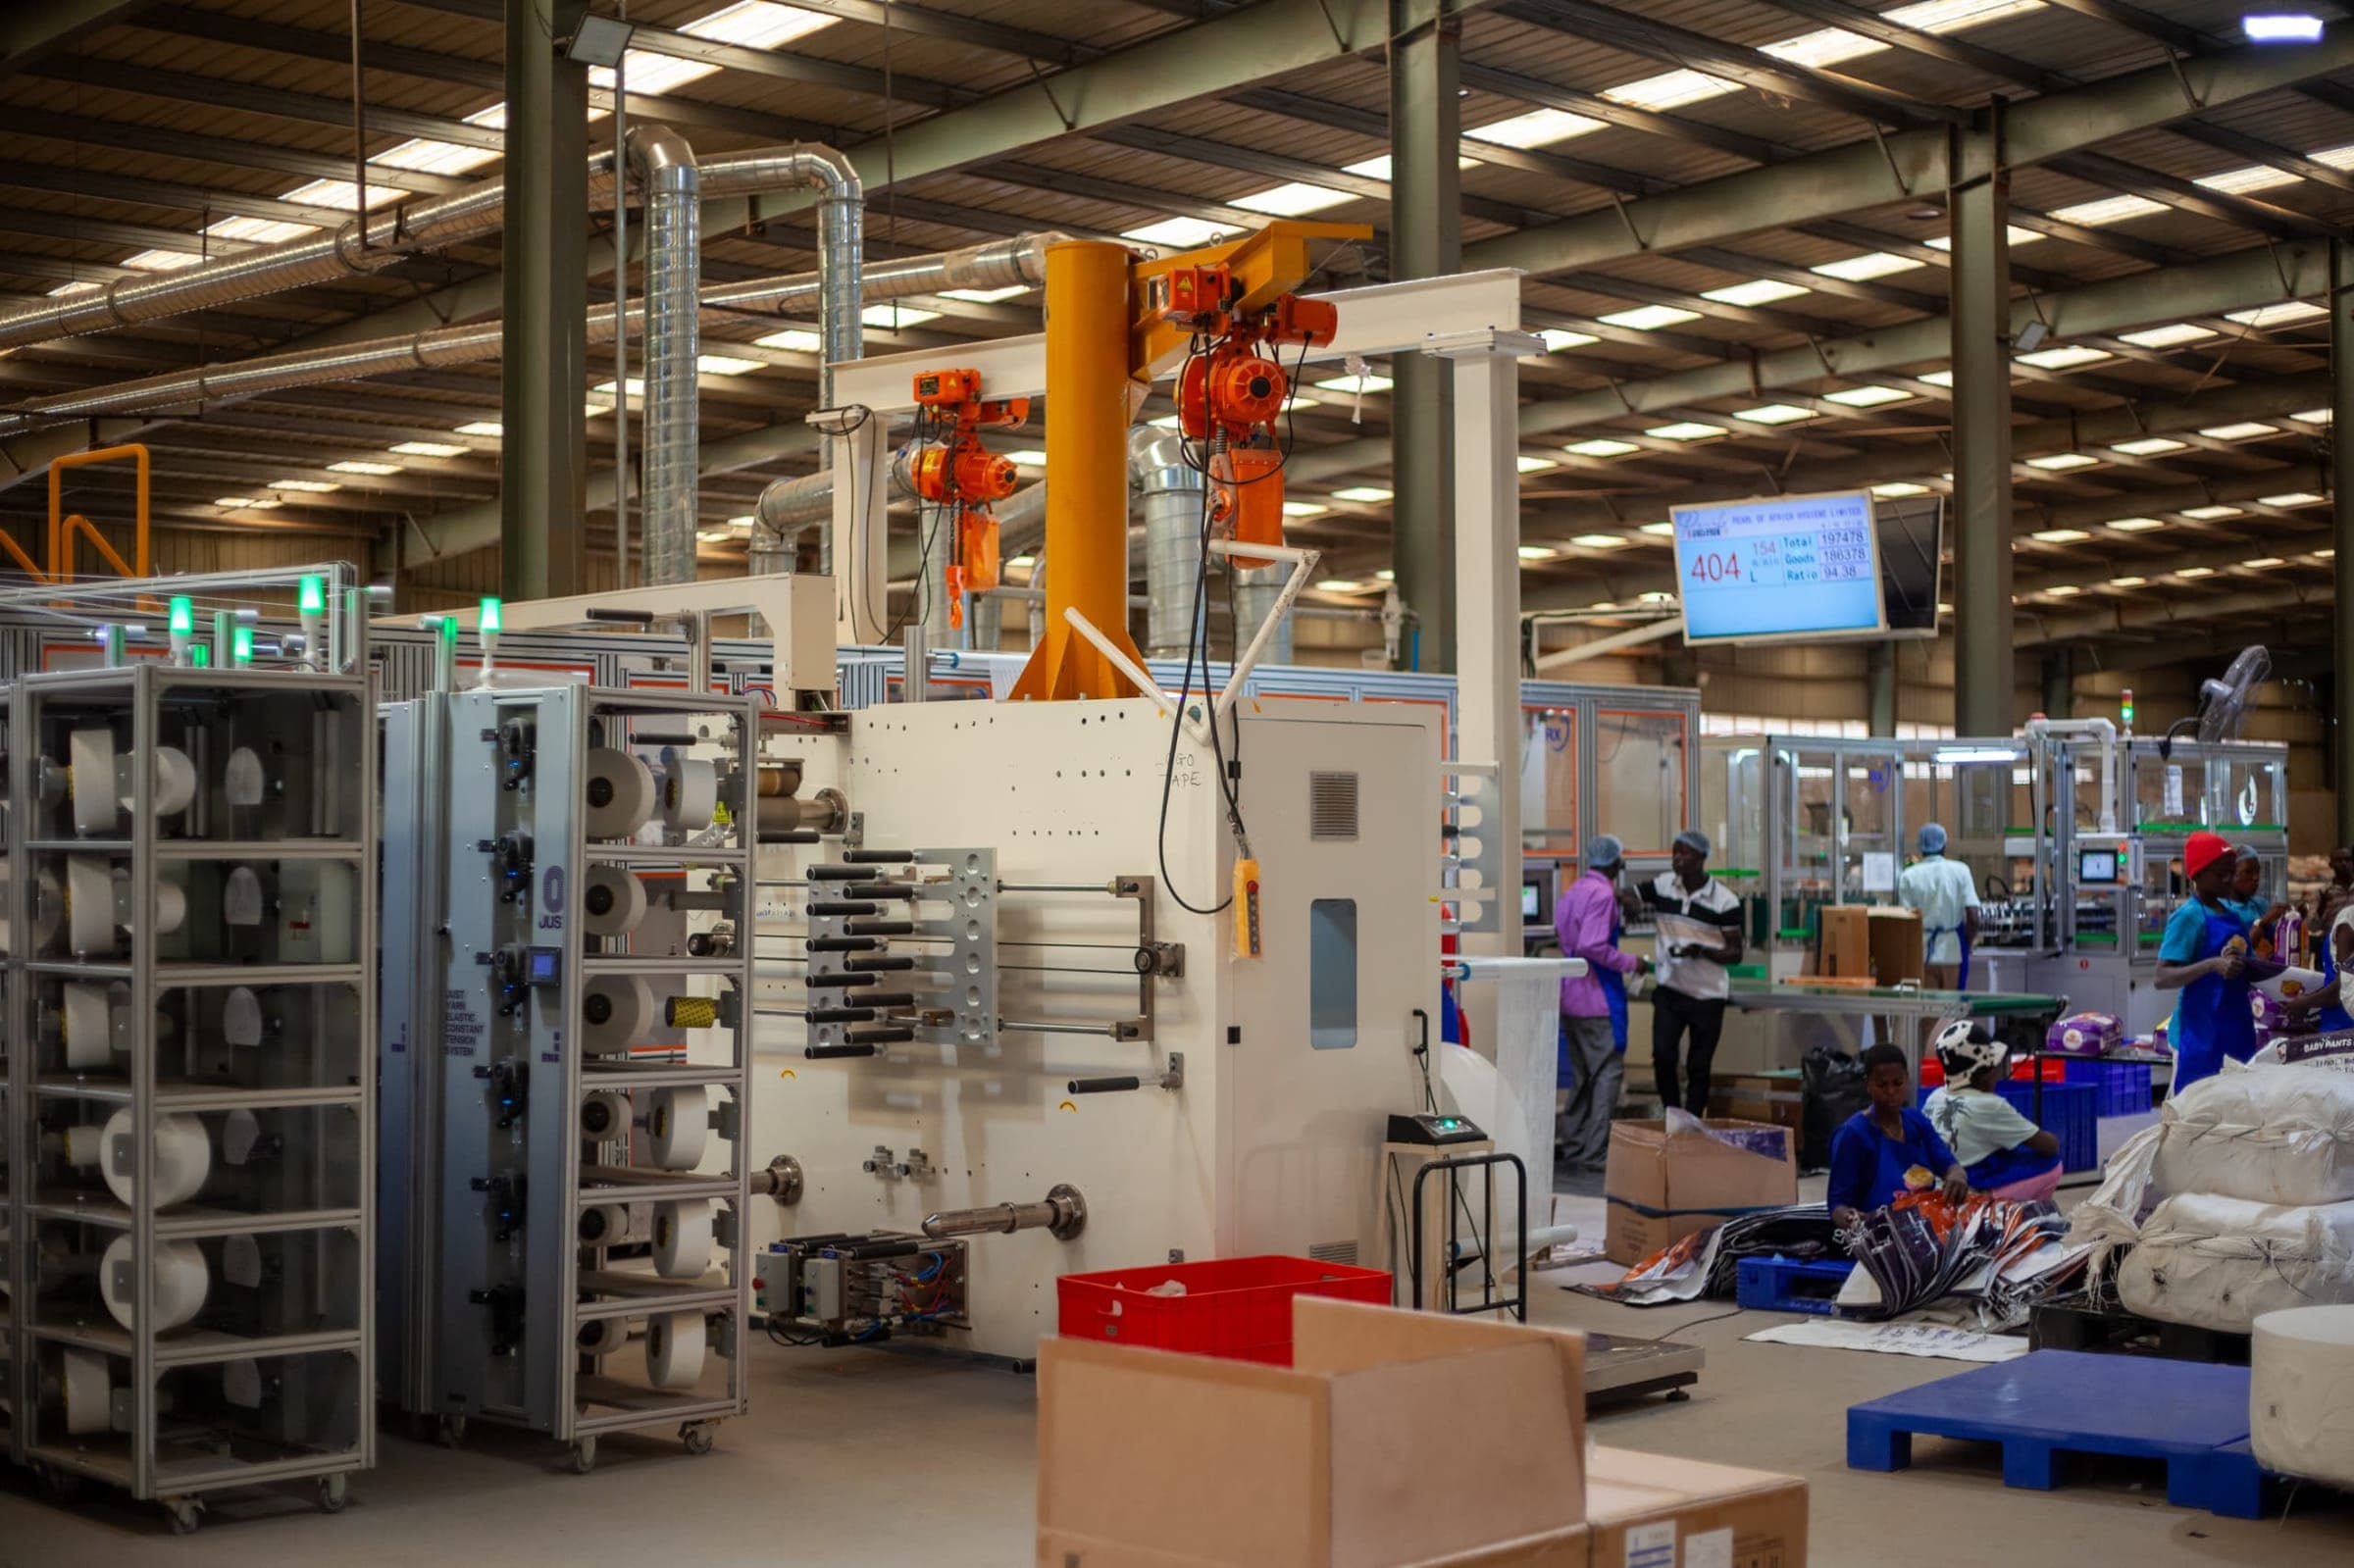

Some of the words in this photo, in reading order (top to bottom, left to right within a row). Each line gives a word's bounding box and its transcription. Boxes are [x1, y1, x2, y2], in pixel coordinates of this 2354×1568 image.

[1783, 535, 1812, 548] Total
[1822, 531, 1865, 544] 197478
[1753, 540, 1776, 556] 154
[1785, 551, 1815, 565] Goods
[1824, 547, 1866, 561] 186378
[1691, 552, 1741, 582] 404
[1787, 570, 1818, 582] Ratio
[538, 914, 564, 930] JUS
[445, 1012, 476, 1022] ELASTIC
[445, 1024, 485, 1035] CONSTANT
[445, 1035, 476, 1044] TENSION
[2304, 1042, 2324, 1053] BABY
[2326, 1038, 2352, 1047] PANTS
[444, 1046, 475, 1056] SYSTEM
